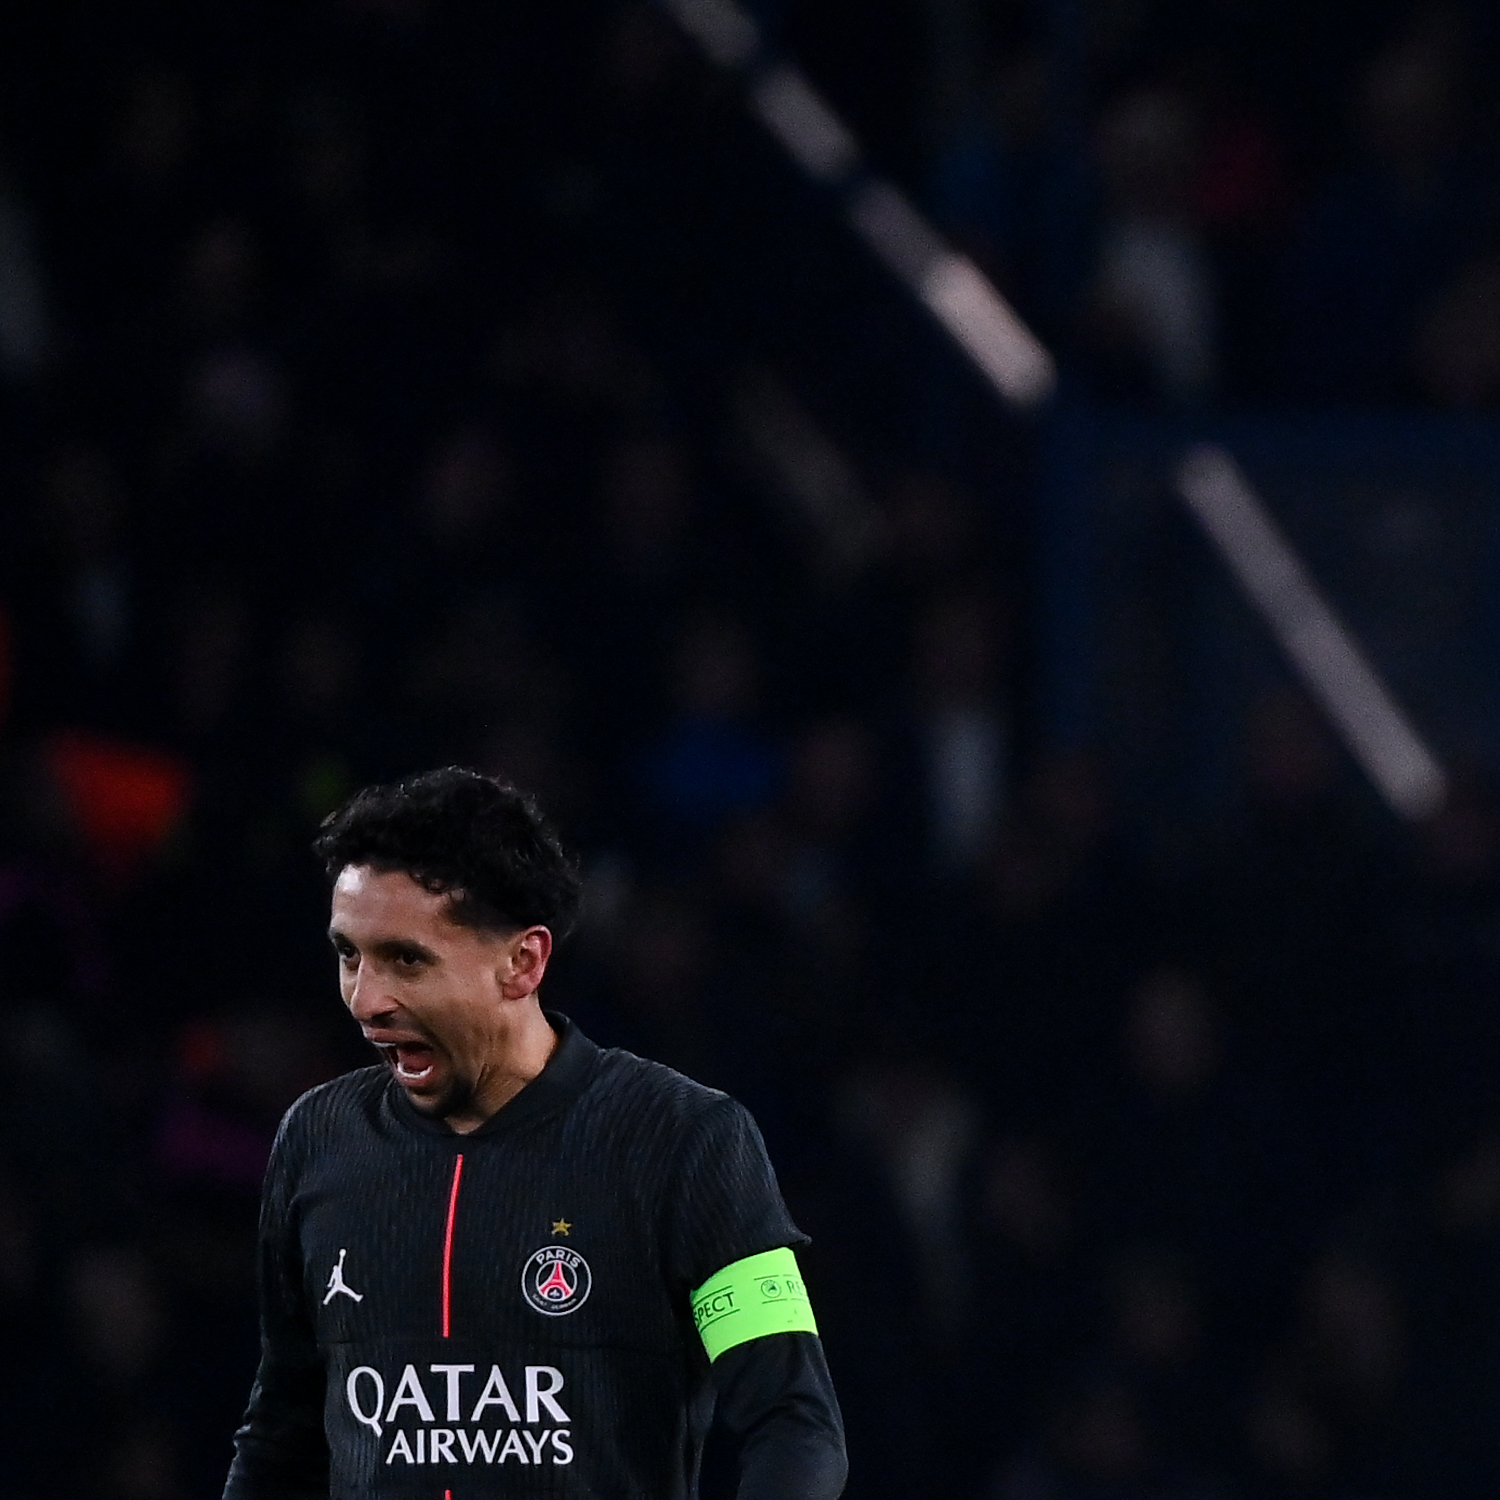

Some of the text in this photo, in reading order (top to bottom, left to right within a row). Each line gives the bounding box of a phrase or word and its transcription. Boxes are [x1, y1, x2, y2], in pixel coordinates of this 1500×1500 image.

[536, 1249, 581, 1268] PARIS
[346, 1364, 572, 1437] QATAR
[385, 1428, 574, 1465] AIRWAYS
